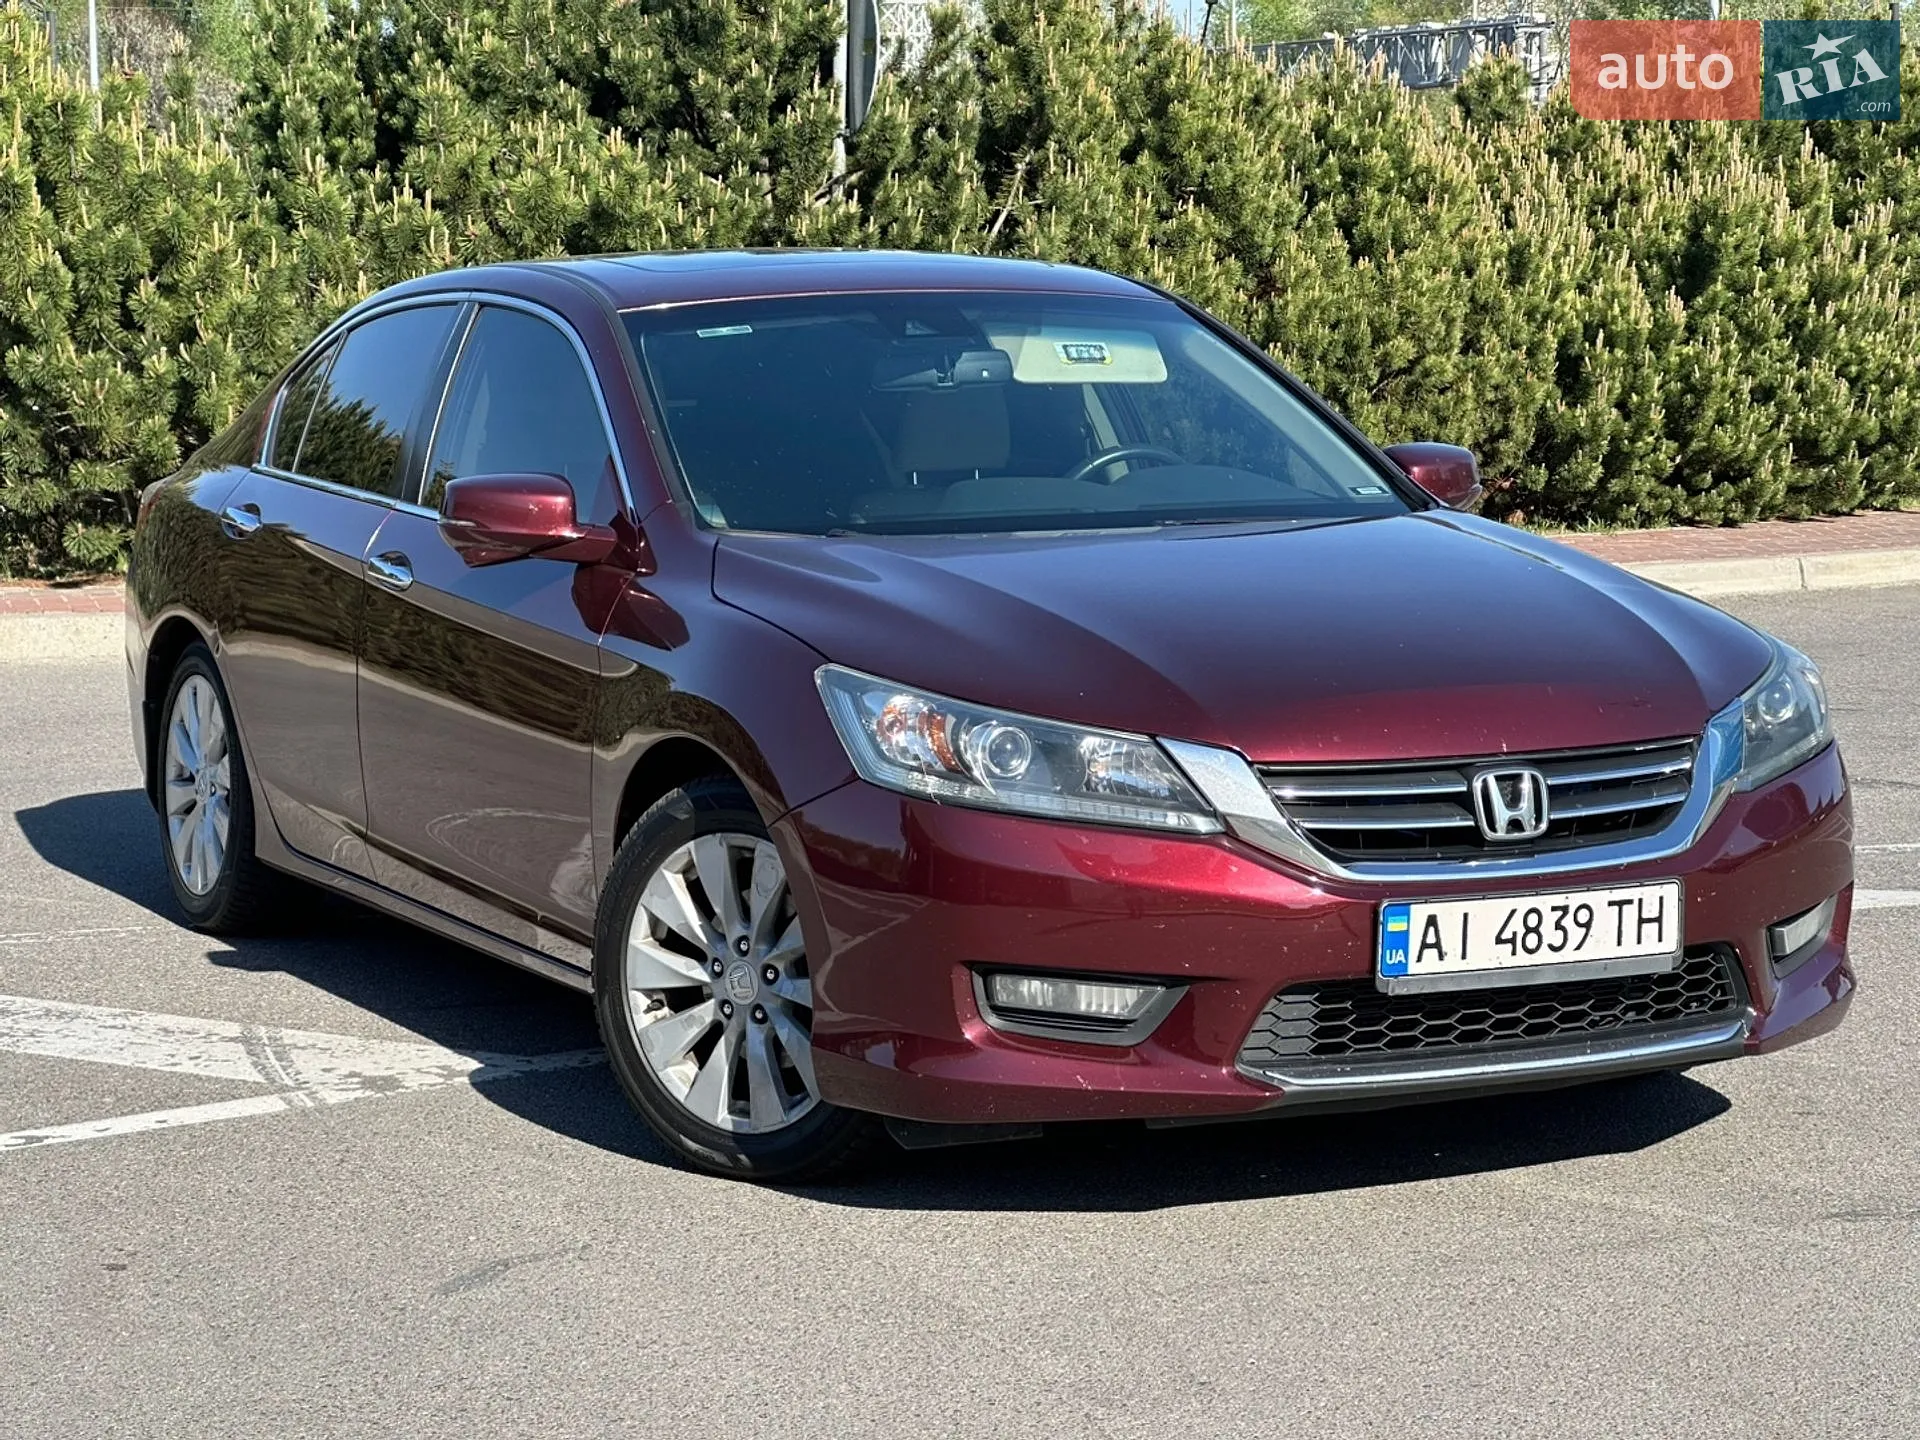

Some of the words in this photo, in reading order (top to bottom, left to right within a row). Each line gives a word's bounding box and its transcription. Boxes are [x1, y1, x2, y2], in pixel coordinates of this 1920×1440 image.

[1495, 902, 1595, 956] 4839
[1607, 895, 1665, 946] TH
[1385, 950, 1407, 965] UA
